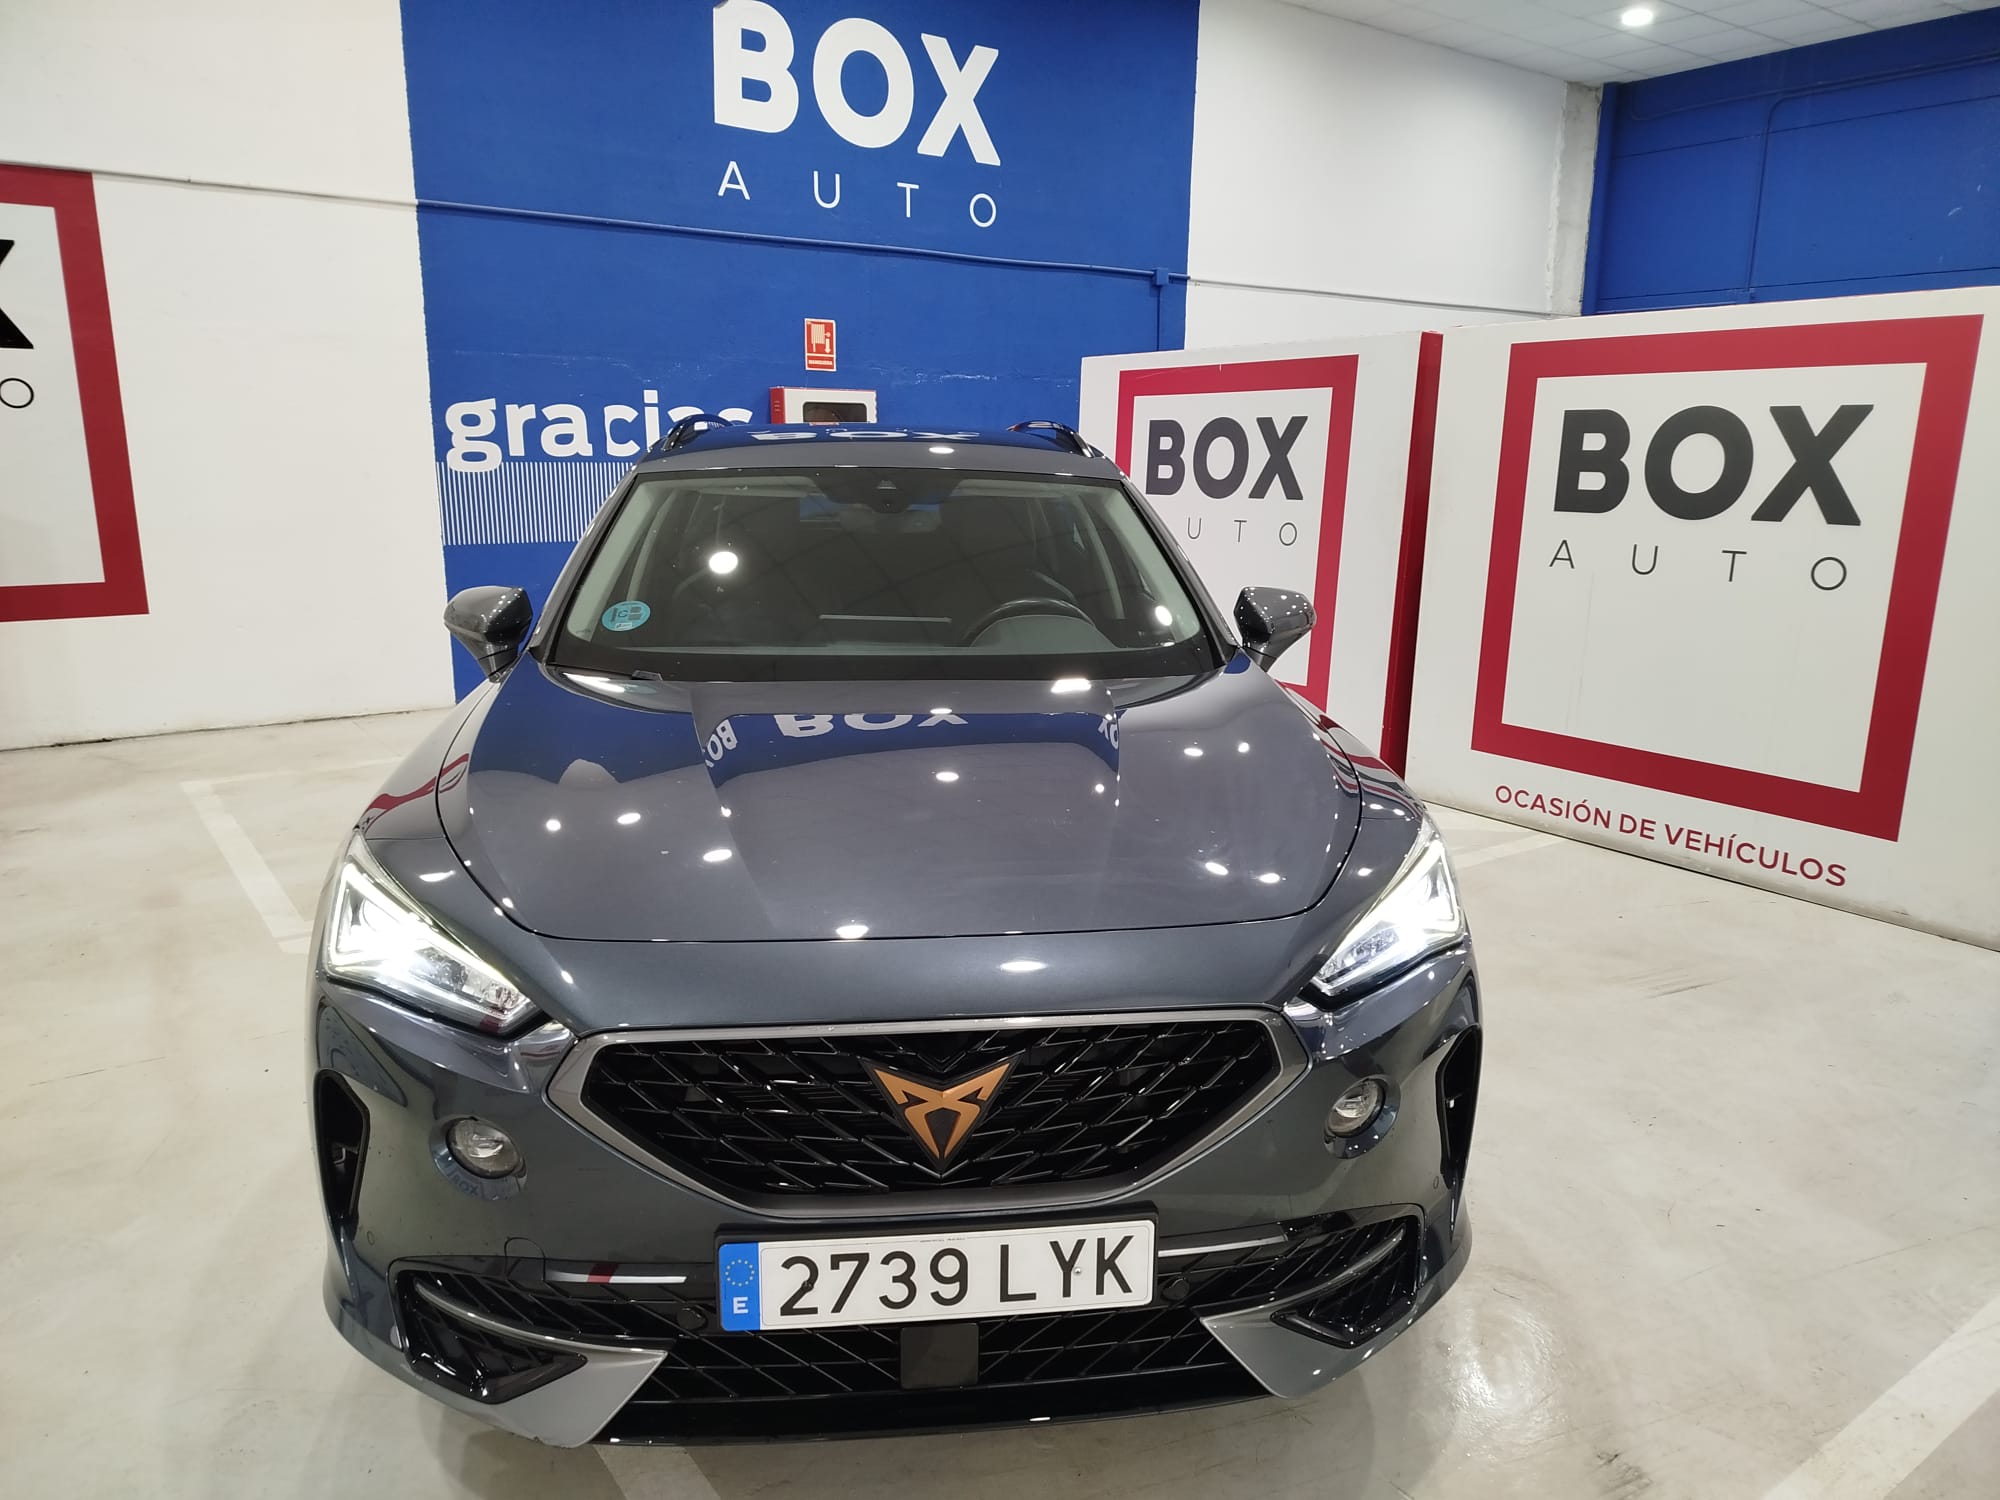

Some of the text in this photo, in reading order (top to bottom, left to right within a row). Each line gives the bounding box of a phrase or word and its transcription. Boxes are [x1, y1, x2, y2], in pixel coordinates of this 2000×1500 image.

[713, 0, 1001, 166] BOX
[717, 161, 997, 228] AUTO
[1146, 416, 1308, 500] BOX
[1554, 404, 1874, 526] BOX
[1187, 517, 1298, 546] UTO
[1549, 539, 1847, 591] AUTO
[1495, 785, 1847, 887] OCASIÓN DE VEHÍCULOS
[732, 1296, 749, 1315] E
[779, 1235, 1135, 1317] 2739 LYK
